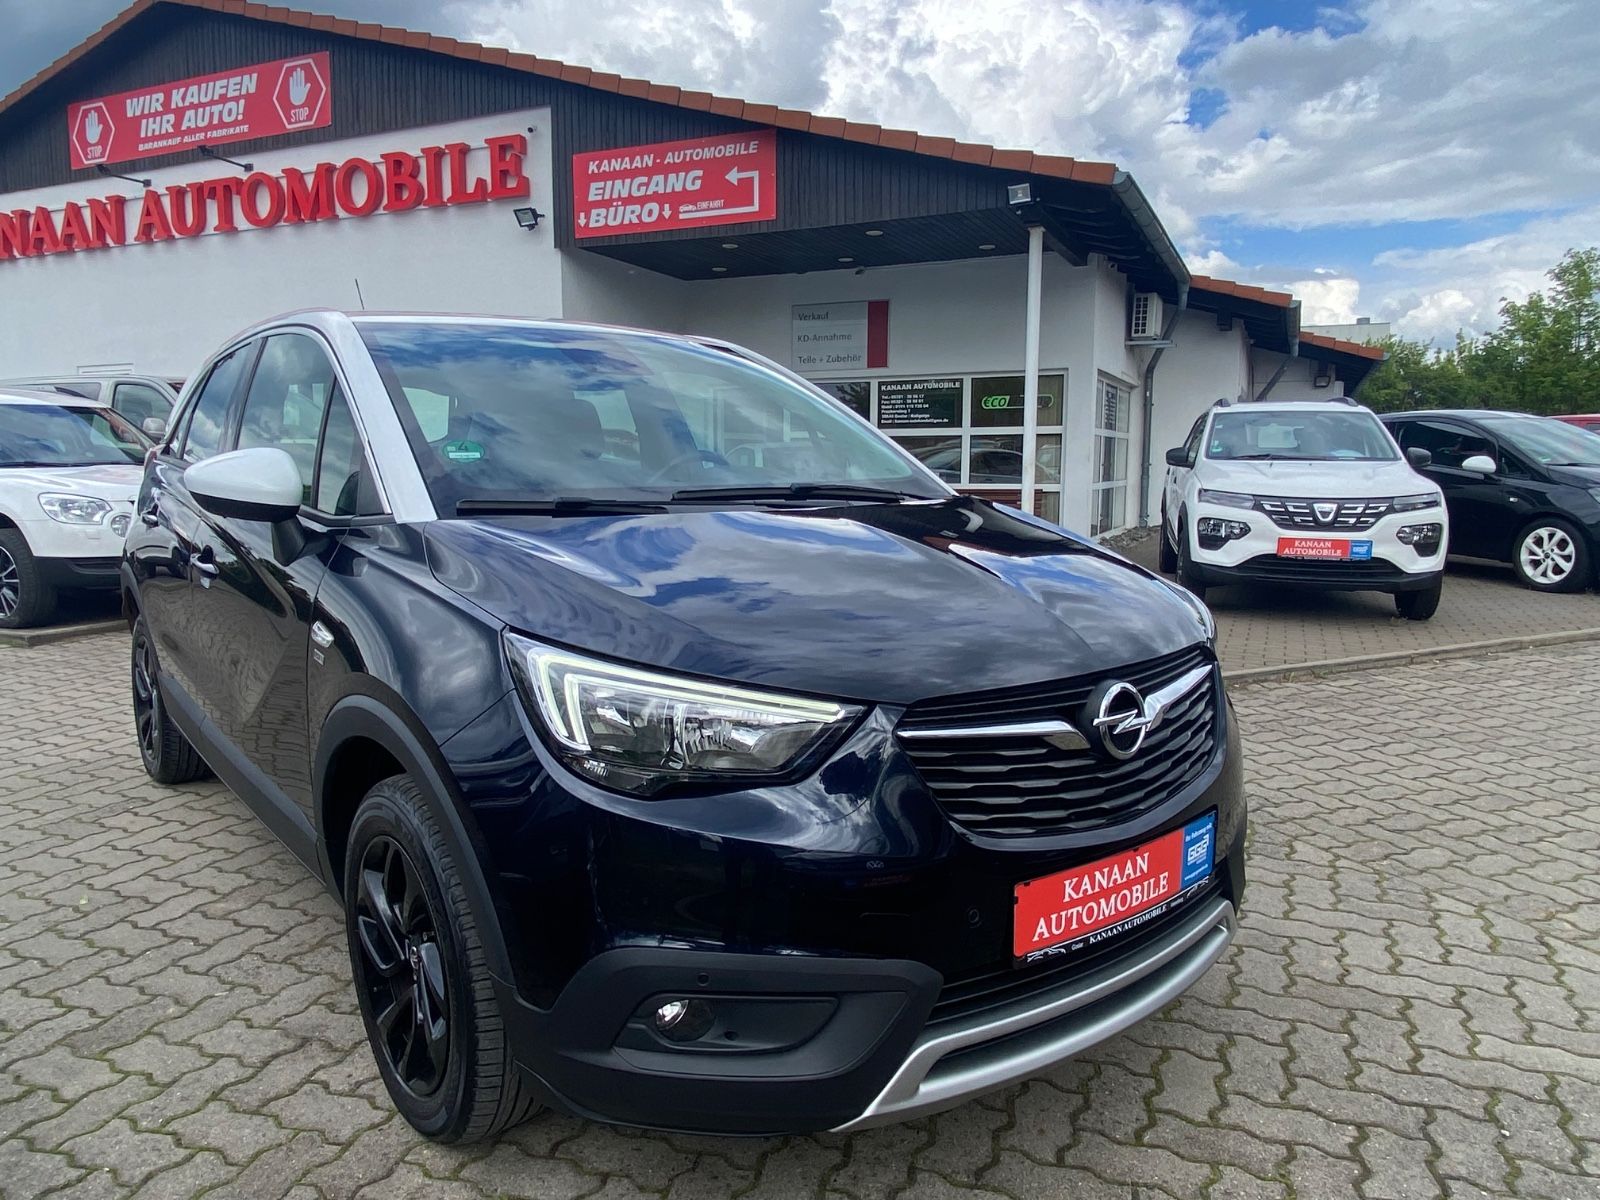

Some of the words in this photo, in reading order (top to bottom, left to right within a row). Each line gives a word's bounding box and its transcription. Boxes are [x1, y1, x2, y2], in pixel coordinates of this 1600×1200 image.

[126, 92, 164, 118] WIR
[171, 73, 258, 110] KAUFEN
[140, 116, 175, 138] IHR
[181, 99, 246, 131] AUTO!
[290, 107, 309, 123] STOP
[138, 136, 181, 151] BARANKAUF
[183, 132, 205, 143] ALLER
[206, 125, 249, 139] FABRIKATE
[87, 146, 102, 159] STOP
[588, 153, 653, 175] KANAAN
[664, 141, 759, 165] AUTOMOBILE
[0, 195, 126, 259] NAAN
[135, 134, 530, 242] AUTOMOBILE
[588, 170, 704, 202] EINGANG
[589, 201, 660, 228] BÜRO
[697, 199, 725, 210] EINFAHRT
[798, 312, 829, 321] Verkauf
[797, 333, 852, 343] KD-Annahme
[798, 356, 816, 364] Teile
[826, 354, 861, 364] Zubehör
[881, 383, 912, 391] KANAAN
[913, 381, 960, 390] AUTOMOBILE
[1283, 547, 1343, 557] AUTOMOBILE
[1294, 540, 1332, 548] KANAAN
[1063, 852, 1150, 903] KANAAN
[1032, 872, 1169, 942] AUTOMOBILE
[1089, 924, 1123, 944] KANAAN
[1122, 904, 1167, 932] AUTOMOBILE
